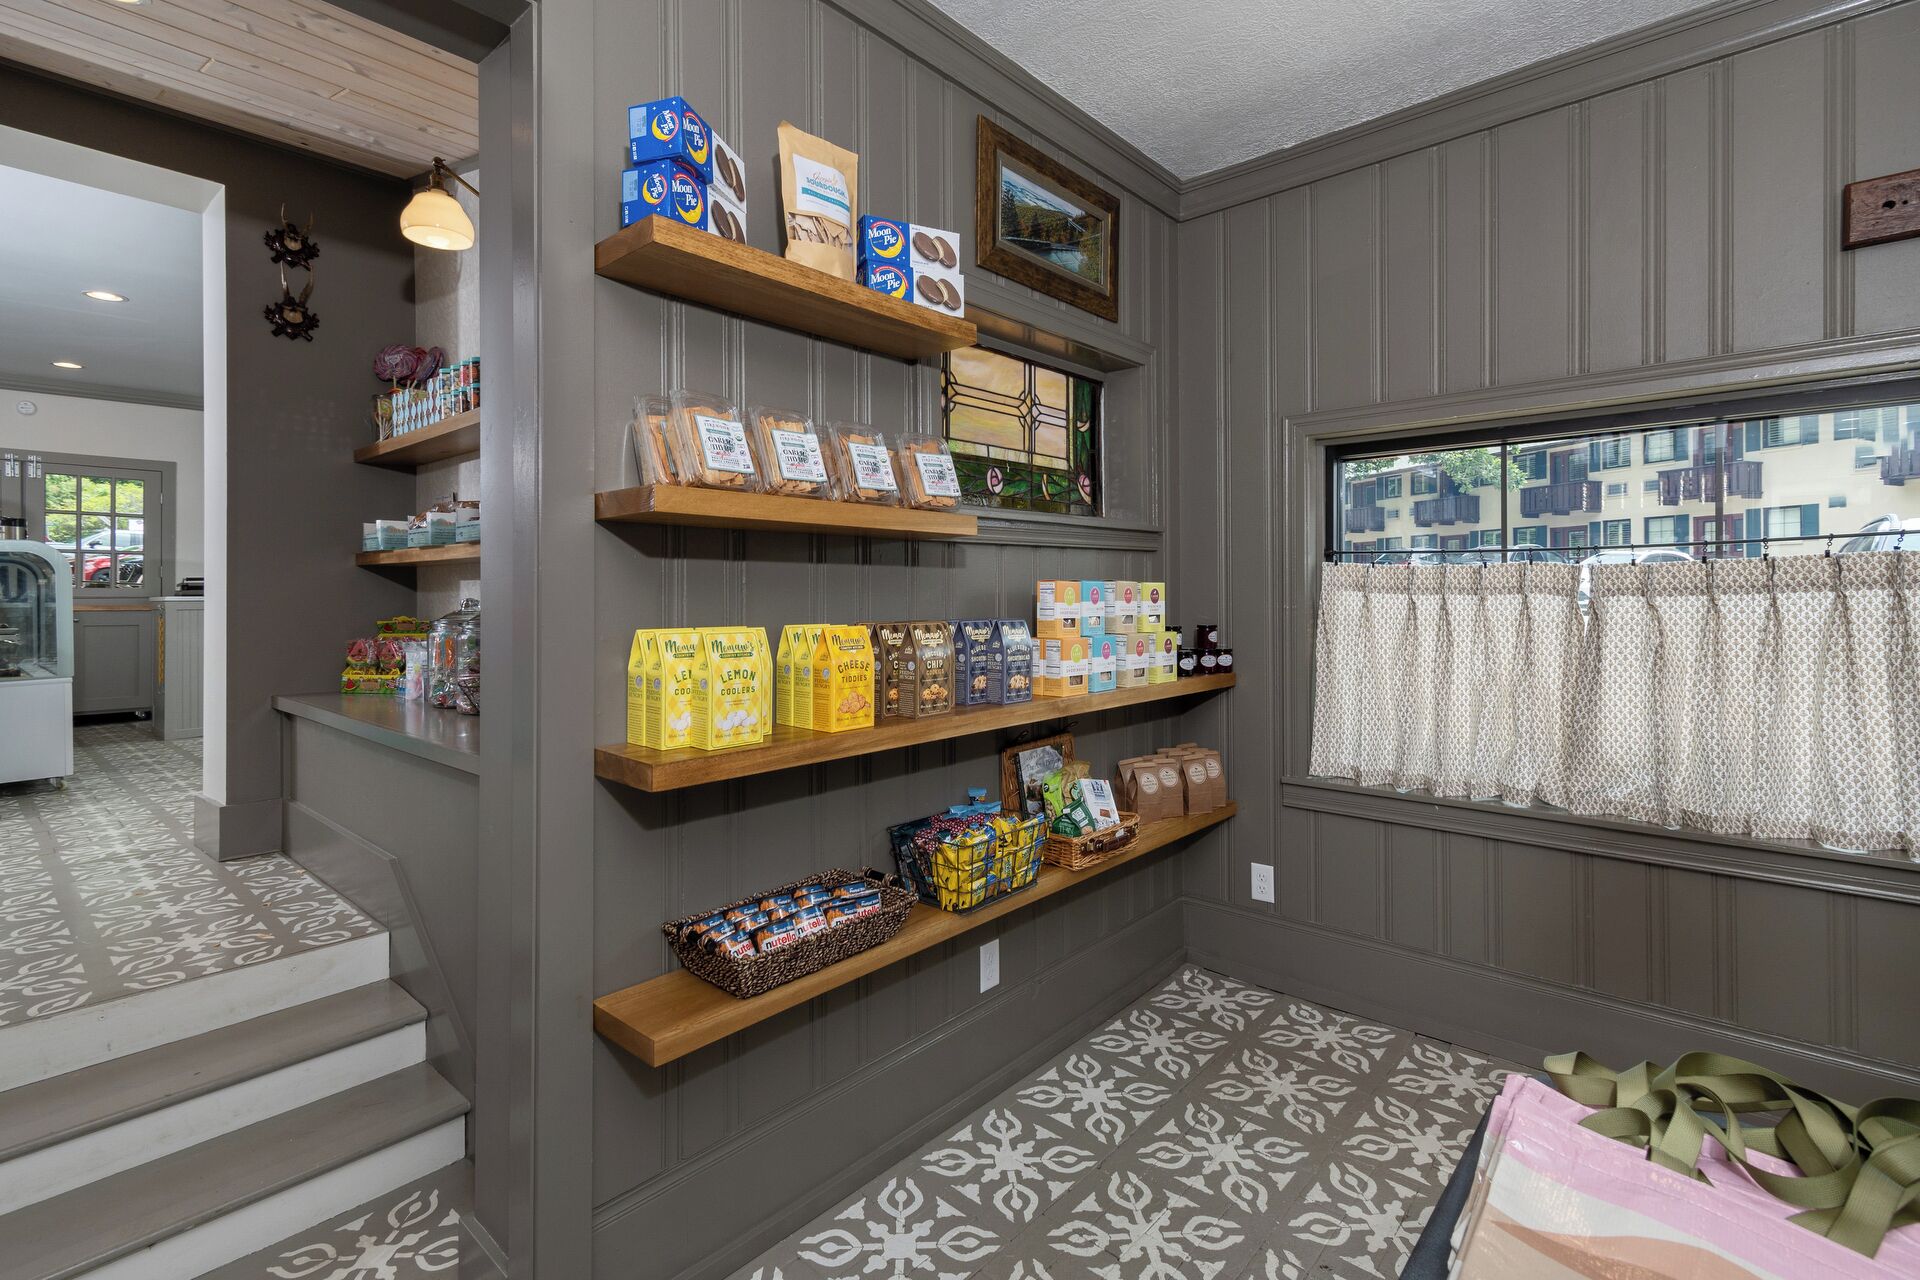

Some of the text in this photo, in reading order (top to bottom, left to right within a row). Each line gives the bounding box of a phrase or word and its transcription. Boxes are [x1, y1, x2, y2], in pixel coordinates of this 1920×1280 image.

[662, 110, 675, 130] Moon
[682, 117, 700, 134] Moon
[660, 123, 670, 136] Pie
[693, 133, 704, 147] Pie
[652, 173, 663, 194] Moon
[671, 179, 693, 194] Moon
[650, 186, 659, 199] Pie
[685, 194, 698, 206] Pie
[867, 227, 892, 239] Moon
[884, 235, 898, 246] Pie
[870, 272, 895, 285] Moon
[886, 279, 900, 291] Pie
[831, 634, 866, 646] Memaw's
[914, 629, 944, 640] Memaw's
[664, 640, 696, 654] Mema
[711, 639, 755, 654] Memaw's
[837, 659, 871, 674] CHEESE
[926, 659, 944, 669] CHIP
[720, 669, 756, 684] LEMON
[720, 686, 756, 696] COOLERS
[797, 918, 826, 935] nutella
[765, 933, 797, 949] nutella
[731, 939, 754, 958] nutel
